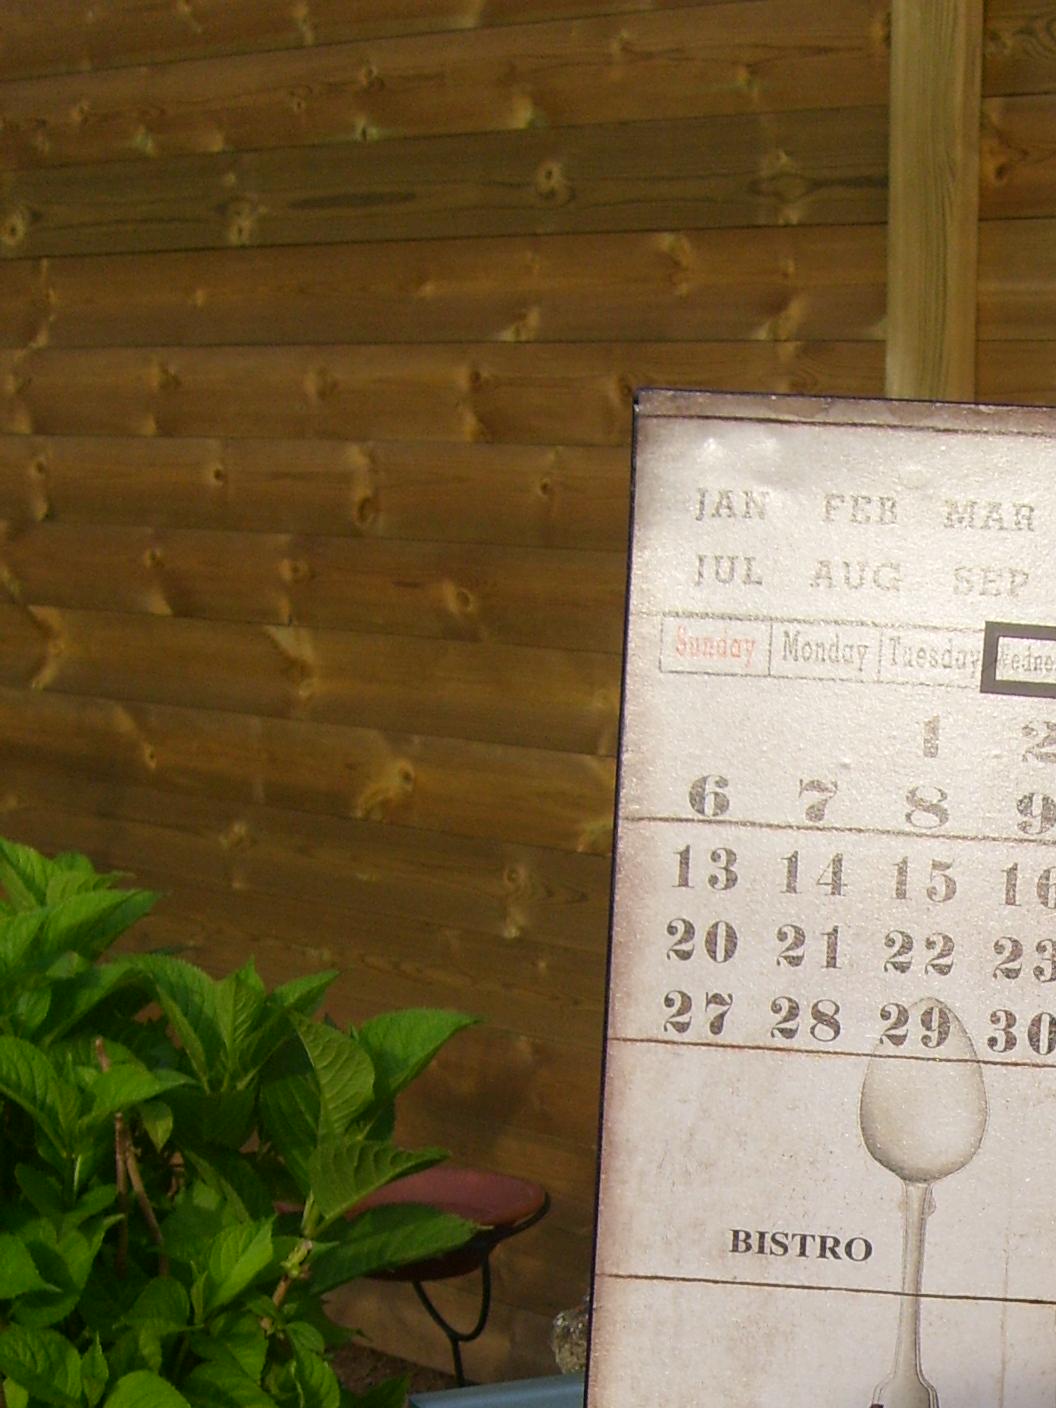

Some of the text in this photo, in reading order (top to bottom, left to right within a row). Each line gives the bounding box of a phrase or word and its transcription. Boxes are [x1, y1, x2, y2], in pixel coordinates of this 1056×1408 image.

[695, 487, 769, 521] JAN
[822, 493, 899, 526] FEB
[943, 500, 1037, 531] MAR
[694, 554, 764, 587] JUL
[809, 559, 902, 592] AUG
[953, 566, 1030, 599] SEP
[675, 626, 756, 668] Sunday
[782, 631, 869, 672] Monday
[889, 637, 982, 678] Tuesday
[923, 714, 941, 758] 1
[688, 774, 731, 817] 6
[799, 778, 838, 822] 7
[905, 785, 949, 829] 8
[672, 845, 739, 891] 13
[780, 850, 848, 896] 14
[893, 856, 957, 903] 15
[666, 918, 739, 963] 20
[776, 924, 842, 970] 21
[884, 929, 955, 976] 22
[663, 990, 734, 1036] 27
[770, 995, 841, 1042] 28
[879, 1002, 951, 1049] 29
[729, 1229, 873, 1262] BISTRO
